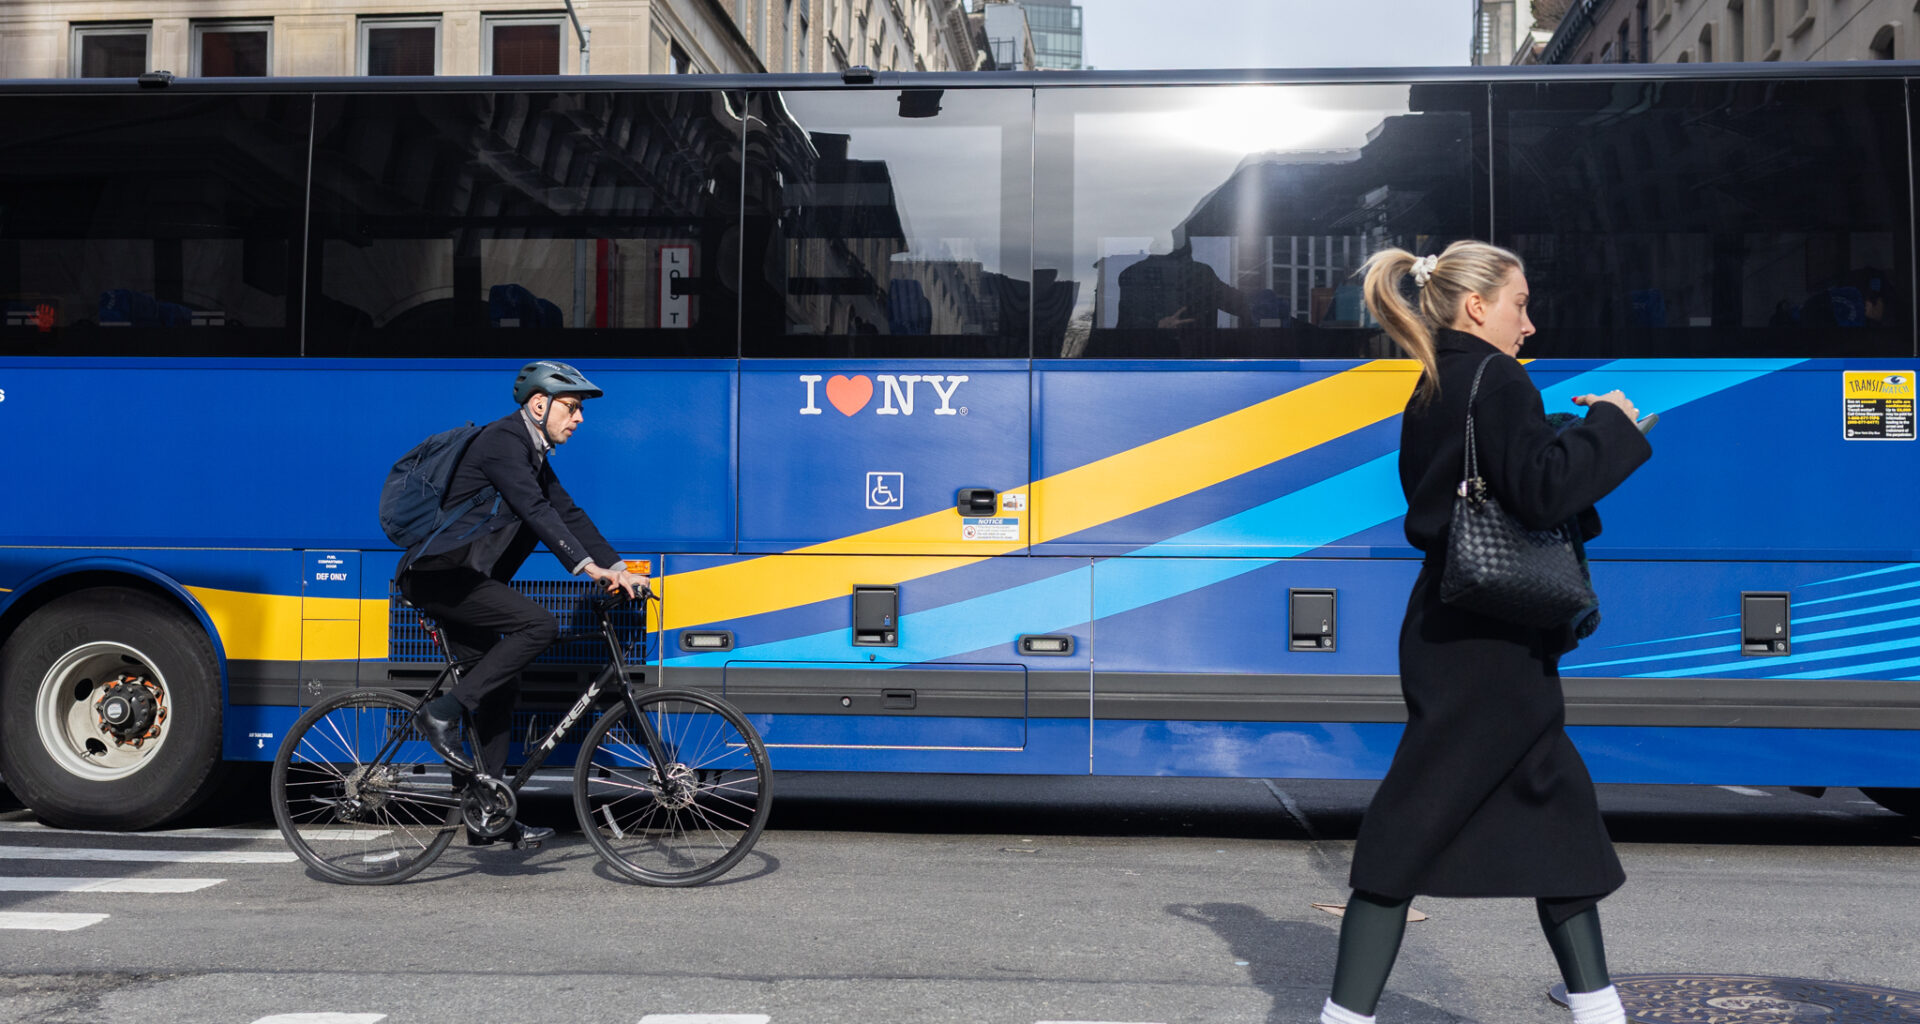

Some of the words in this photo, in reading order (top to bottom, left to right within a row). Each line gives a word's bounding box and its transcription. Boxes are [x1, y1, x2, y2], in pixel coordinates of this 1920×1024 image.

[799, 374, 823, 415] I
[1849, 379, 1884, 392] TRANSIT
[316, 572, 329, 581] DEF
[330, 572, 347, 581] ONLY
[541, 682, 600, 750] TREK
